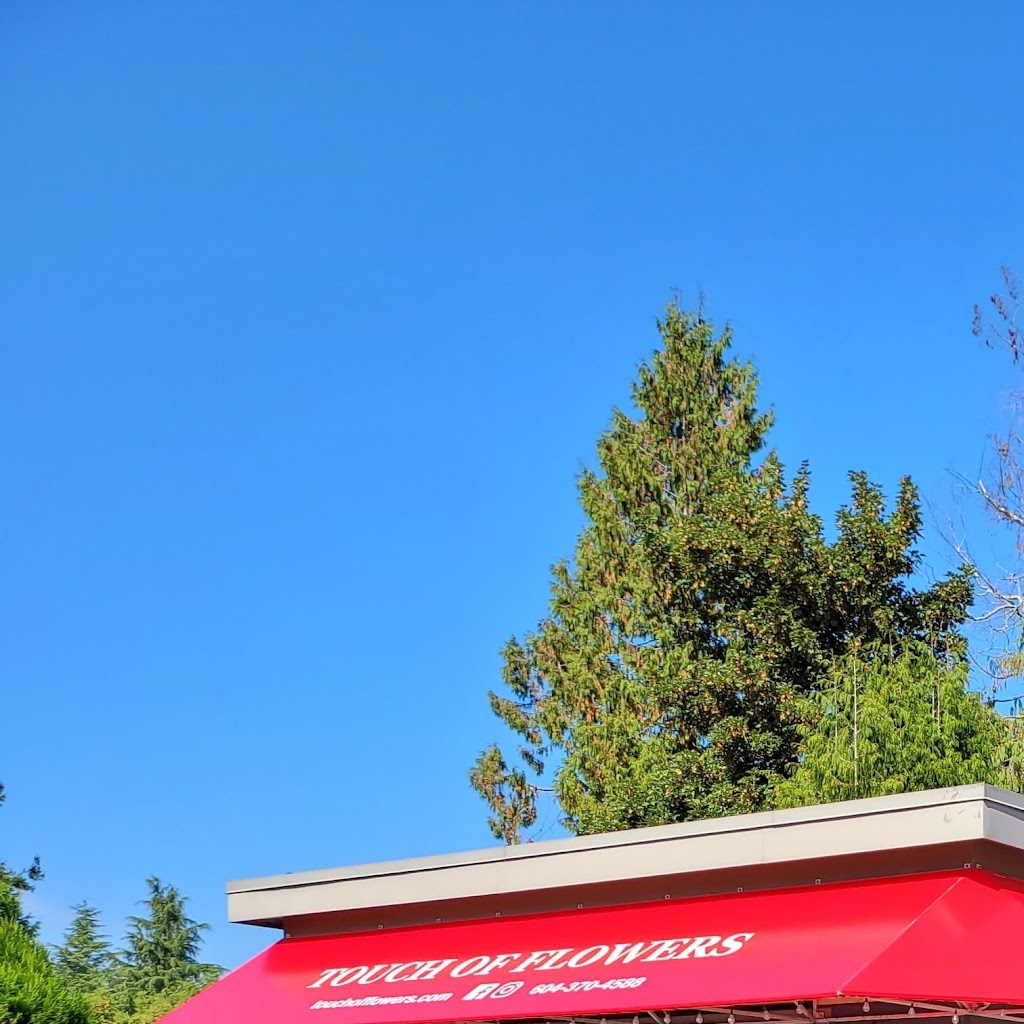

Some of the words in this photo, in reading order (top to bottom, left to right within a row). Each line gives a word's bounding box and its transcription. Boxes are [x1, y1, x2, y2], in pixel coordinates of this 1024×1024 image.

[306, 958, 458, 989] TOUCH
[450, 953, 523, 978] OF
[509, 932, 755, 973] FLOWERS
[529, 976, 648, 995] 604-370-4588
